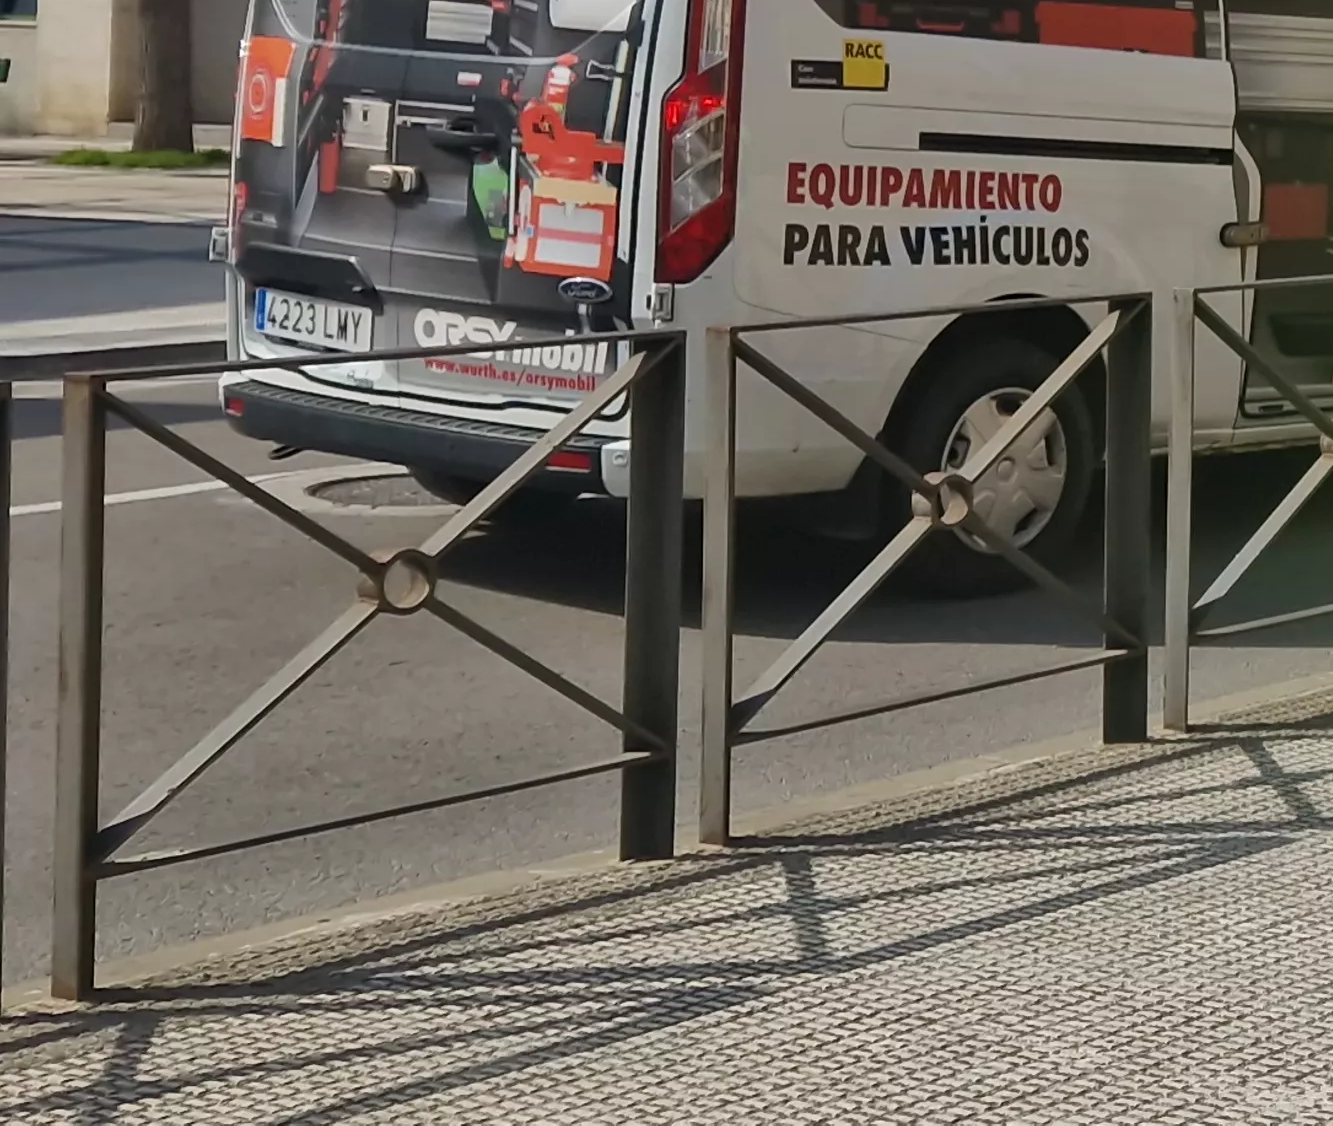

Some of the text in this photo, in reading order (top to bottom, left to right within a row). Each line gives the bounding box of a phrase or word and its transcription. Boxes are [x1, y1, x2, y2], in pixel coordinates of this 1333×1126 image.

[845, 42, 884, 60] RACC
[786, 161, 1063, 213] EQUIPAMIENTO
[783, 214, 1090, 267] PARA VEHÍCULOS
[267, 295, 363, 345] 4223 LMY
